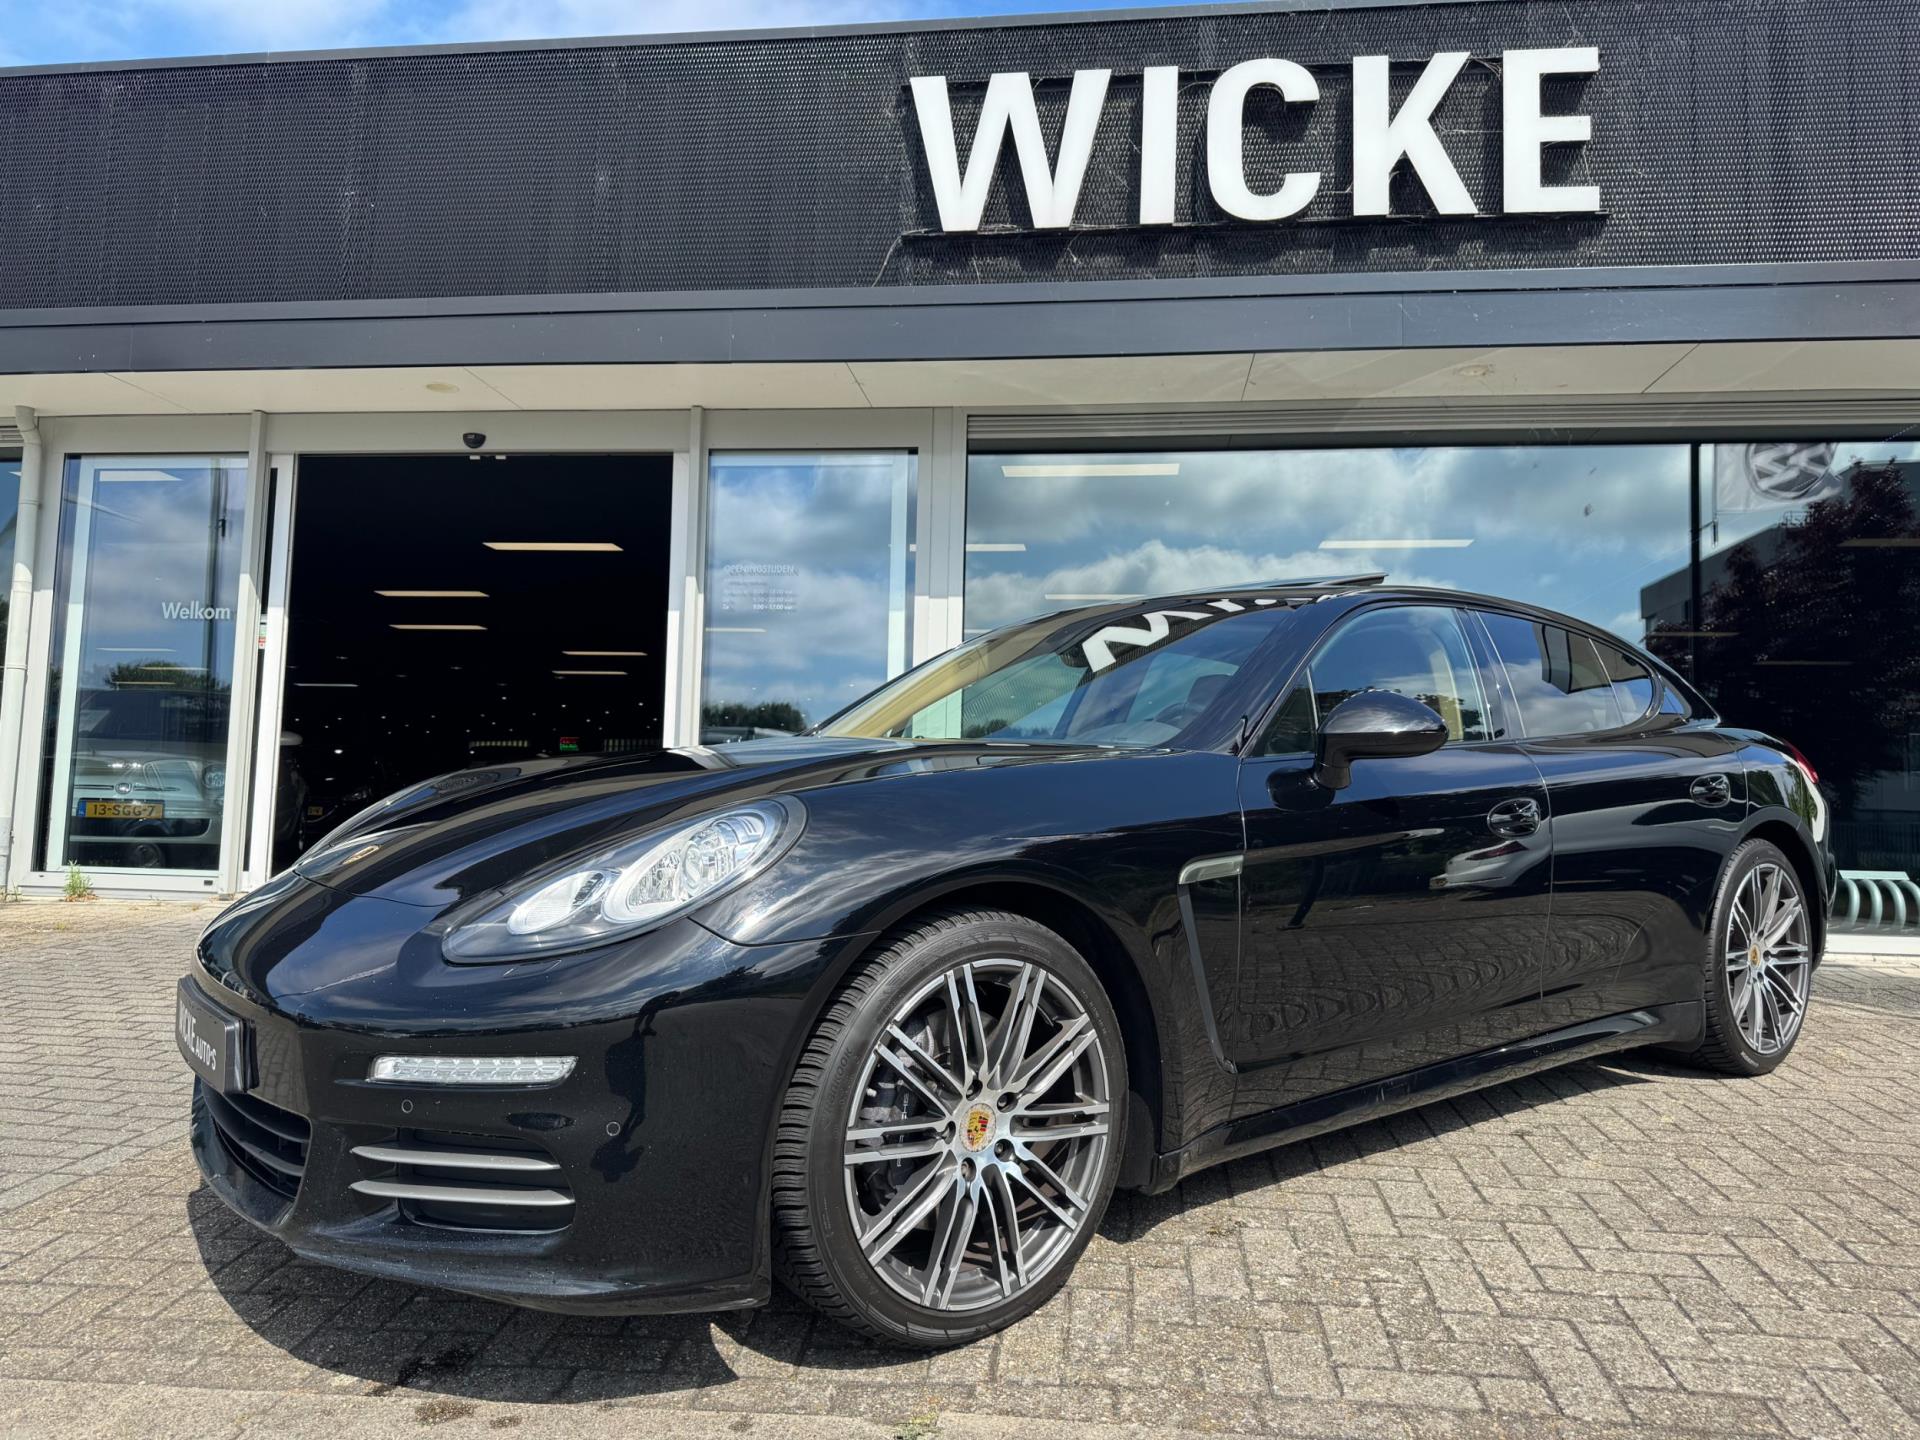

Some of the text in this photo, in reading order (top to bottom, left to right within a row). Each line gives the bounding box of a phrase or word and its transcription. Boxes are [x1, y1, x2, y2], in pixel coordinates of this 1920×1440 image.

[910, 46, 1601, 232] WICKE
[161, 600, 231, 620] Welkom
[93, 804, 156, 816] 13-SGG-7
